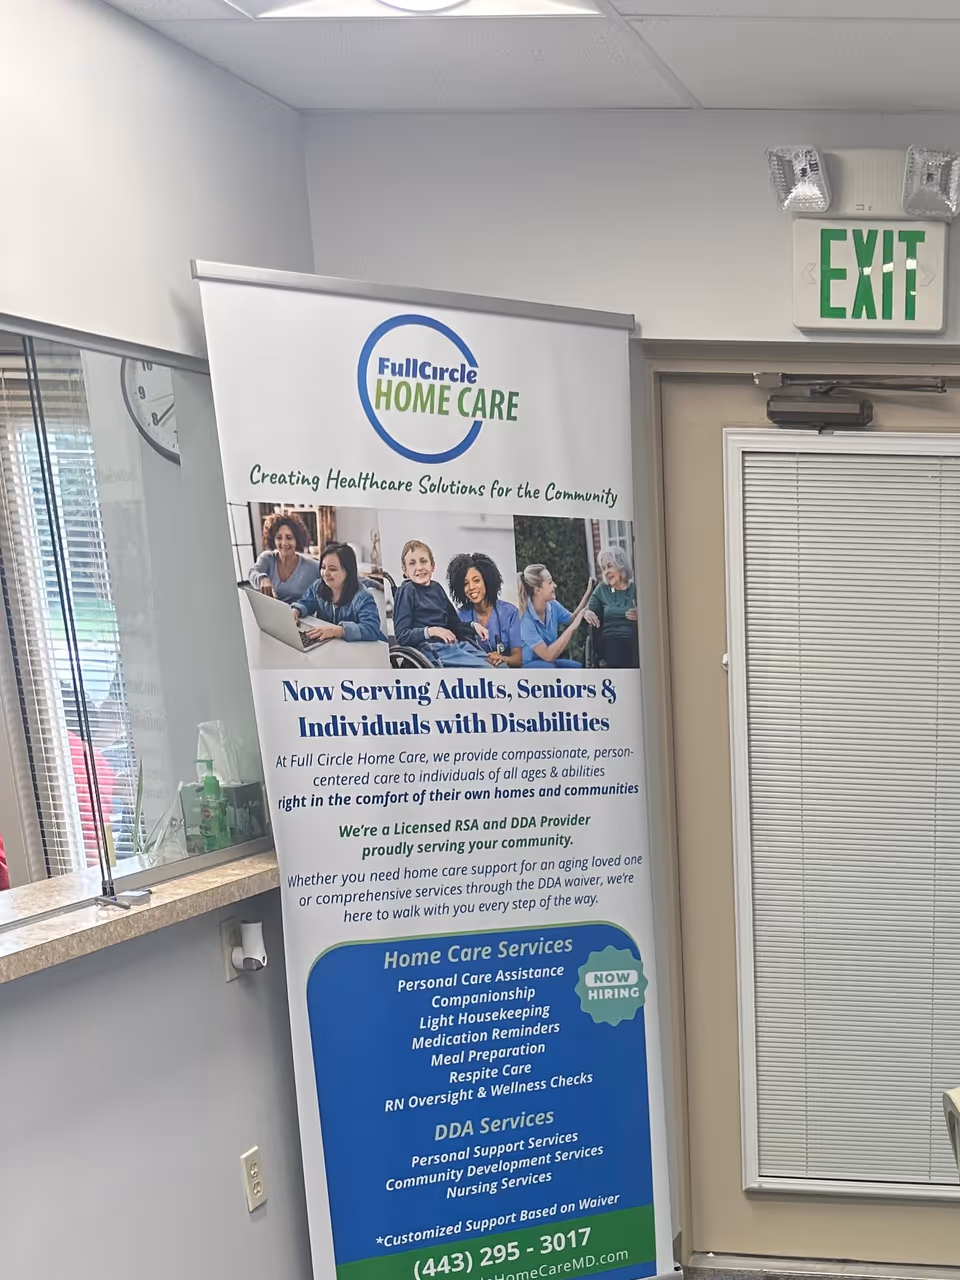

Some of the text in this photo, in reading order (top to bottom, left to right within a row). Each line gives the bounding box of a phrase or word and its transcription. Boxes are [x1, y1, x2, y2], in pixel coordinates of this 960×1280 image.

[820, 228, 926, 320] EXIT
[378, 357, 478, 384] FullCircle
[138, 386, 146, 400] 9
[374, 378, 520, 422] HOME CARE
[152, 412, 159, 426] 8
[249, 463, 618, 509] Creating Healthcare Solutions for the Community
[281, 677, 616, 705] Now Serving Adults, Seniors &
[298, 711, 609, 737] Individuals with Disabilities
[275, 746, 634, 768] At Full Circle Home Care, we provide compassionate, person-
[278, 782, 639, 812] right in the comfort of their own homes and communities
[338, 813, 591, 838] We're a Licensed RSA and DDA Provider
[287, 854, 643, 888] Whether you need home care support for an aging loved one
[383, 938, 572, 969] Home Care Services
[397, 966, 564, 992] Personal Care Assistance
[594, 972, 630, 983] NOW
[431, 985, 535, 1008] Companionship
[588, 987, 640, 1000] HIRING
[419, 1005, 550, 1031] Light Housekeeping
[411, 1022, 560, 1050] Medication Reminders
[430, 1042, 545, 1066] Meal Preparation
[449, 1063, 532, 1084] Respite Care
[384, 1071, 593, 1112] RN Oversight & Wellness Checks
[434, 1111, 554, 1141] DDA Services
[411, 1132, 578, 1167] Personal Support Services
[385, 1145, 603, 1191] Community Development Services
[446, 1172, 552, 1199] Nursing Services
[464, 1212, 517, 1232] Support
[519, 1203, 557, 1221] Based
[559, 1202, 575, 1213] on
[578, 1194, 620, 1210] Waiver
[479, 1241, 520, 1266] 295
[539, 1226, 591, 1254] 3017
